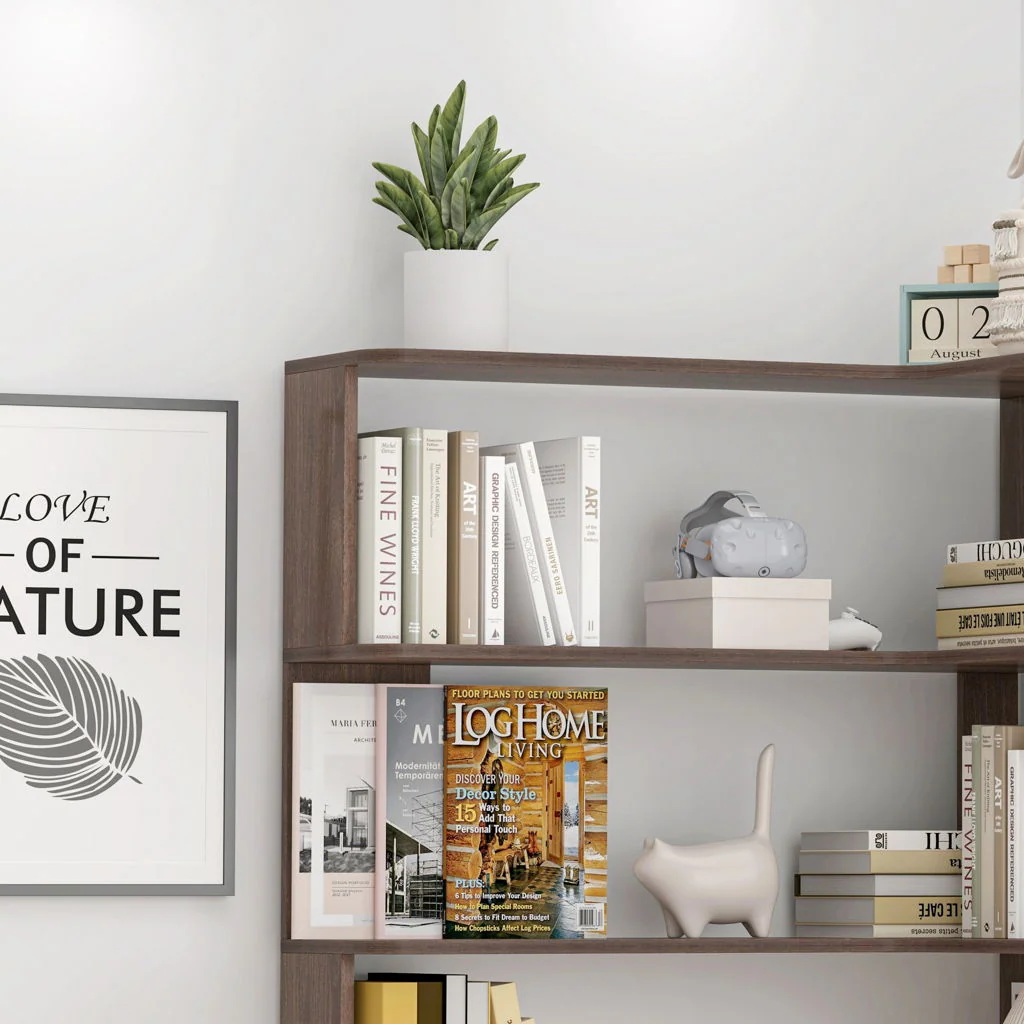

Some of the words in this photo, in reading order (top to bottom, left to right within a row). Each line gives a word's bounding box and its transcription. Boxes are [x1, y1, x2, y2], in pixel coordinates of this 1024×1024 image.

[930, 348, 981, 361] August
[379, 465, 397, 521] FINE
[463, 481, 477, 515] ART
[491, 472, 499, 513] GRAPHIC
[0, 490, 110, 524] LOVE
[584, 486, 598, 519] ART
[491, 515, 499, 548] DESIGN
[26, 537, 84, 573] OF
[522, 535, 540, 584] BORDEAUX
[379, 533, 397, 616] WINES
[491, 550, 499, 609] REFERENCED
[0, 585, 181, 637] ATURE
[452, 689, 480, 698] FLOOR
[482, 690, 511, 699] PLANS
[513, 690, 524, 699] TO
[527, 690, 543, 699] GET
[546, 691, 564, 699] YOU
[566, 691, 605, 700] STARTED
[330, 719, 358, 728] MARIA
[497, 742, 563, 758] LIVING
[395, 761, 441, 771] Modernität
[455, 773, 496, 784] DISCOVER
[499, 774, 520, 784] YOUR
[455, 788, 497, 801] Decor
[499, 787, 537, 803] Style
[963, 764, 973, 817] FINE
[994, 776, 1002, 809] ART
[455, 803, 477, 823] 15
[479, 803, 500, 813] Ways
[502, 803, 511, 812] to
[478, 814, 495, 823] Add
[497, 814, 516, 823] That
[455, 825, 491, 834] Personal
[493, 825, 518, 834] Touch
[963, 829, 973, 911] WINES
[454, 879, 486, 888] PLUS:
[490, 903, 512, 911] Special
[918, 903, 944, 920] CAFÉ
[946, 902, 958, 917] LE
[529, 914, 550, 922] Budget
[469, 925, 500, 933] Chopsticks
